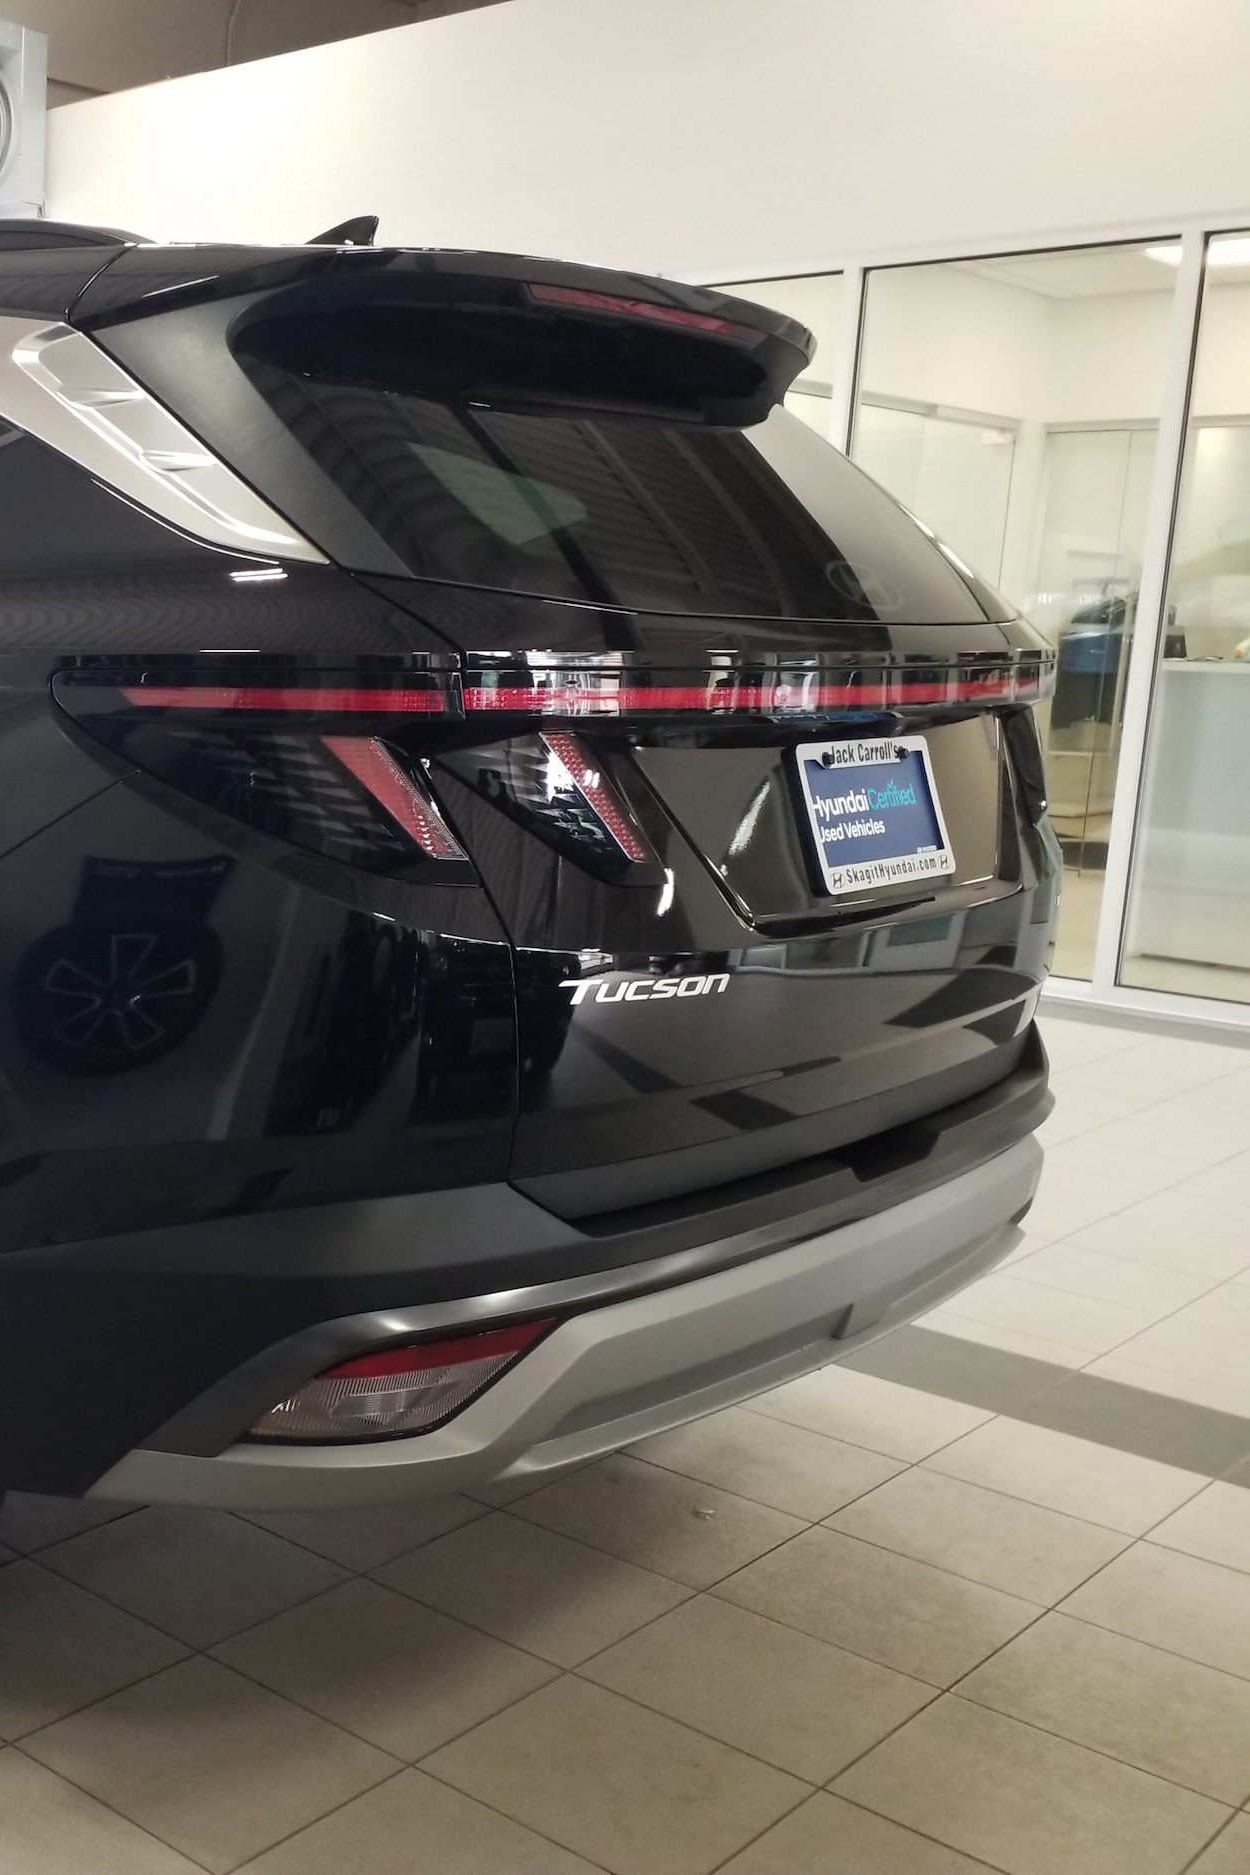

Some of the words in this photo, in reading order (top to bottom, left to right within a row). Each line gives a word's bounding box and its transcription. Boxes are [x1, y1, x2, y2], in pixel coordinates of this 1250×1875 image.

[829, 744, 855, 765] Jack
[857, 741, 899, 762] Carroll's
[813, 788, 869, 822] Hyundai
[867, 778, 917, 810] Certified
[843, 818, 886, 839] Vehicles
[846, 858, 937, 884] SkagitHyundai.com
